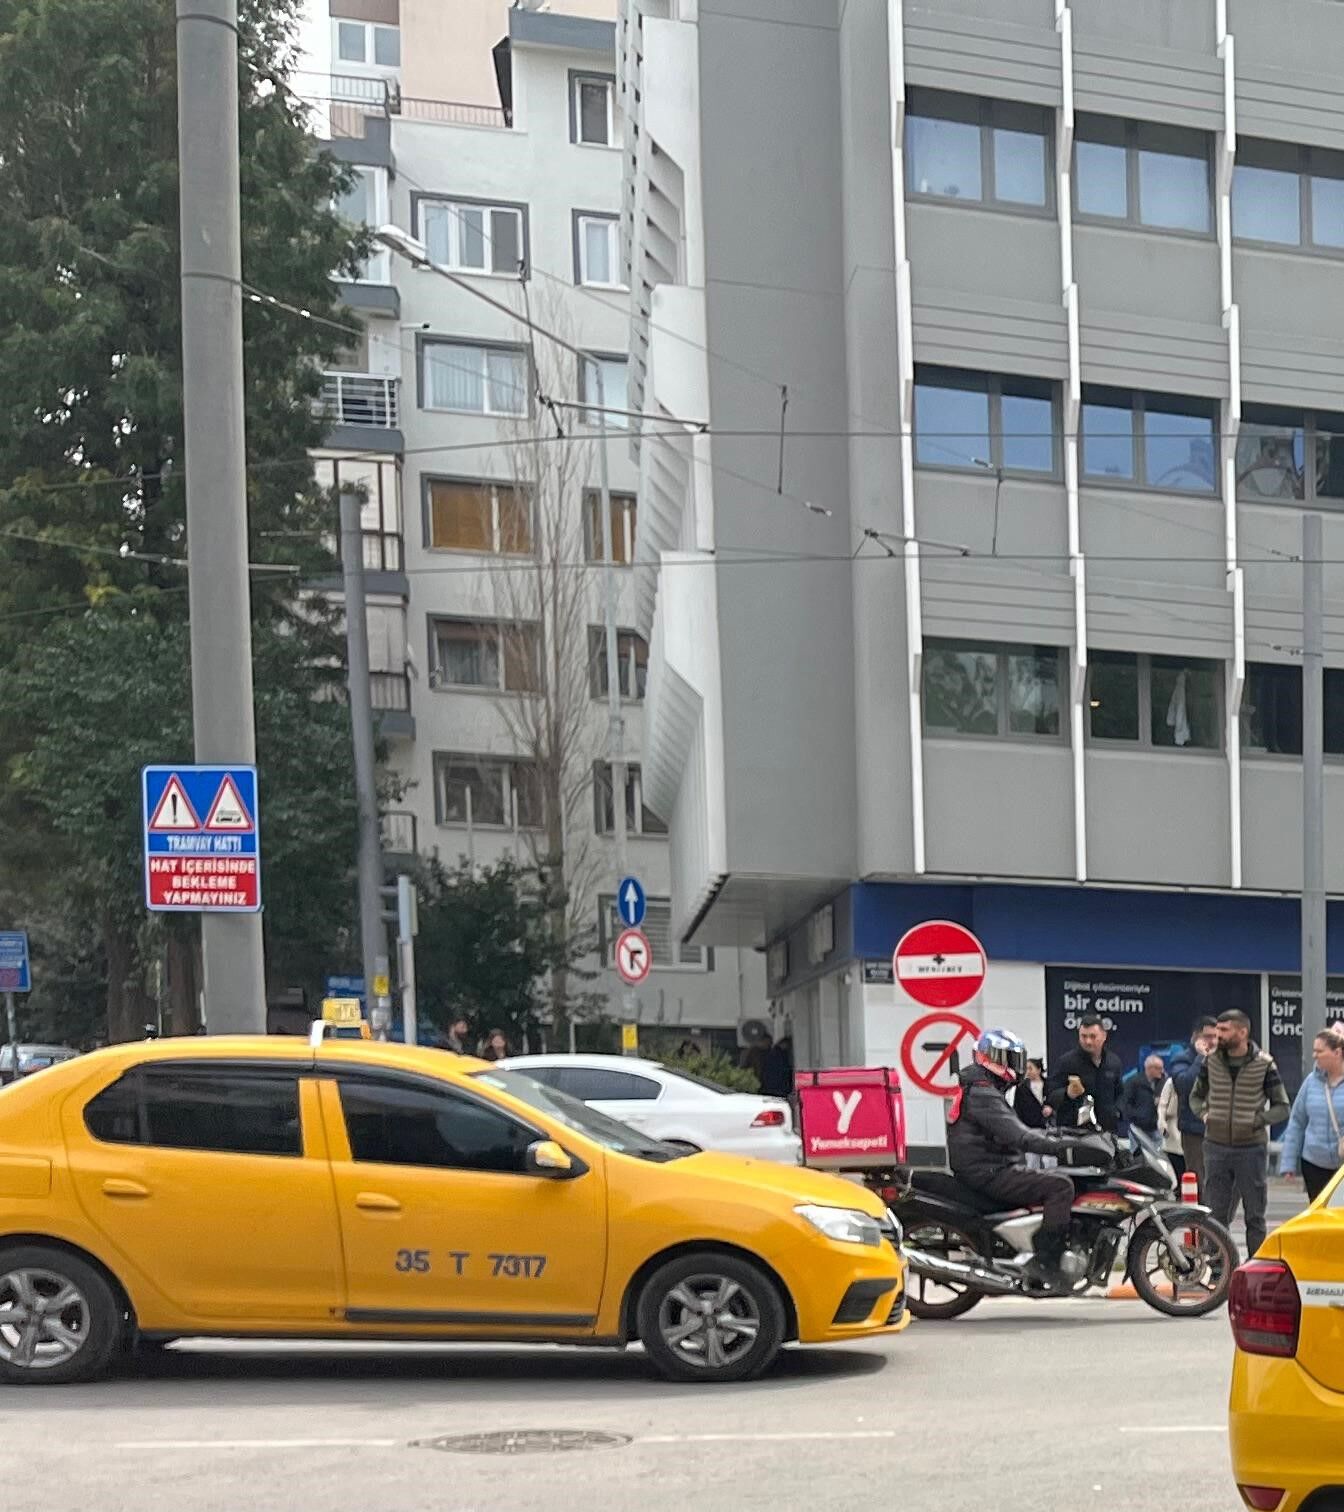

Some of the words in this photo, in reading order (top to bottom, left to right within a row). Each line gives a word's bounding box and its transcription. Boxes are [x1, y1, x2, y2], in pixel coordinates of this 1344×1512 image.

[167, 835, 212, 851] TRAMVAY
[214, 835, 242, 851] HATTI
[151, 859, 177, 873] HAT
[181, 857, 256, 875] İÇERİSİNDE
[172, 875, 237, 890] BEKLEME
[163, 891, 247, 906] YAPMAYINIZ
[1064, 994, 1091, 1011] bir
[1095, 996, 1144, 1013] adım
[1272, 1000, 1297, 1017] bir
[832, 1090, 863, 1134] Y
[395, 1249, 431, 1273] 35
[448, 1252, 470, 1275] T
[487, 1254, 547, 1278] 7317
